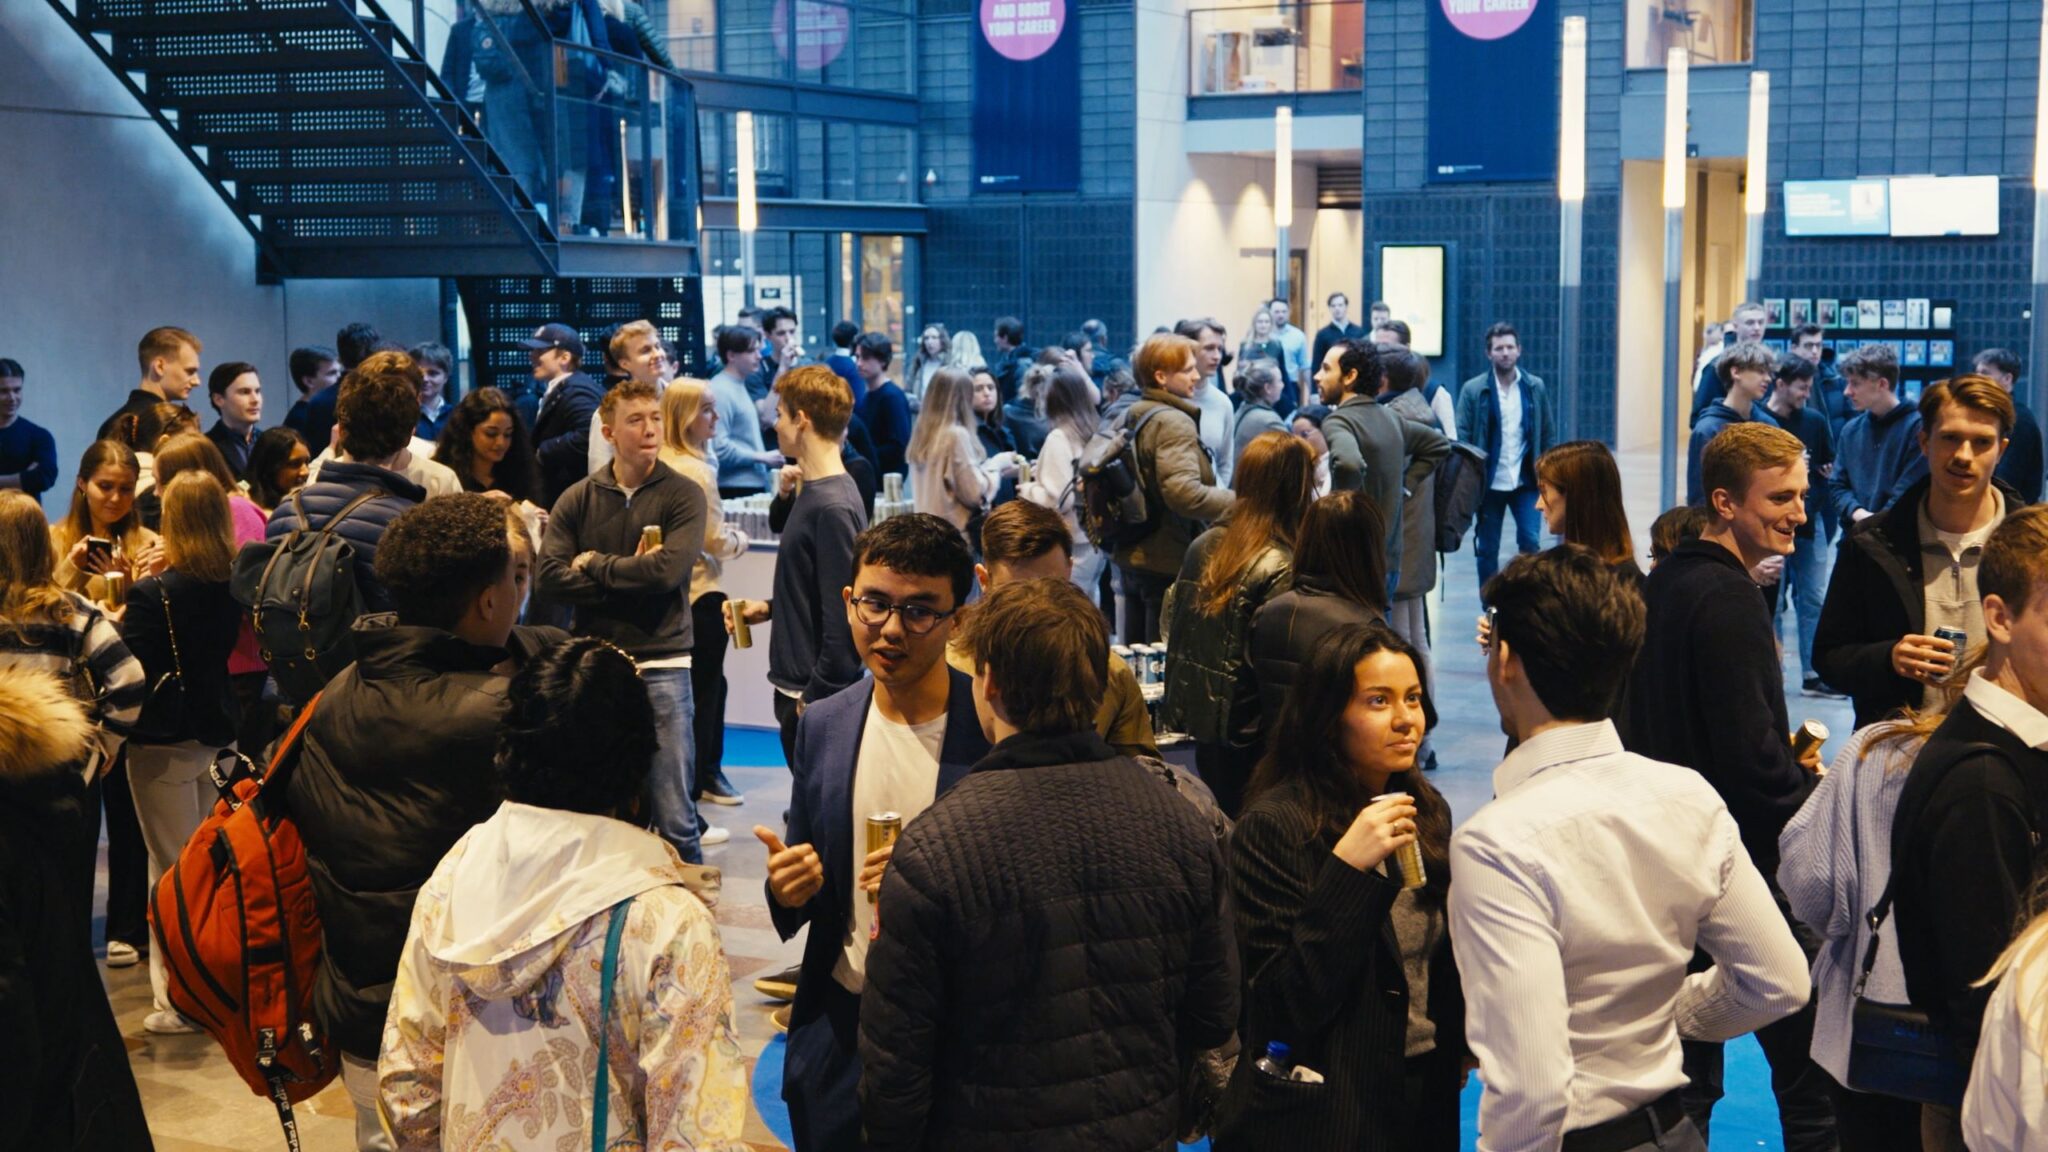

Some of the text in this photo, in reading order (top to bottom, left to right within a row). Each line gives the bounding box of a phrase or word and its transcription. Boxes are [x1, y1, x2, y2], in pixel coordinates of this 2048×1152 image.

[993, 1, 1050, 18] AND BOOST
[1448, 0, 1529, 14] YOUR CAREER
[988, 19, 1057, 36] YOUR CAREER
